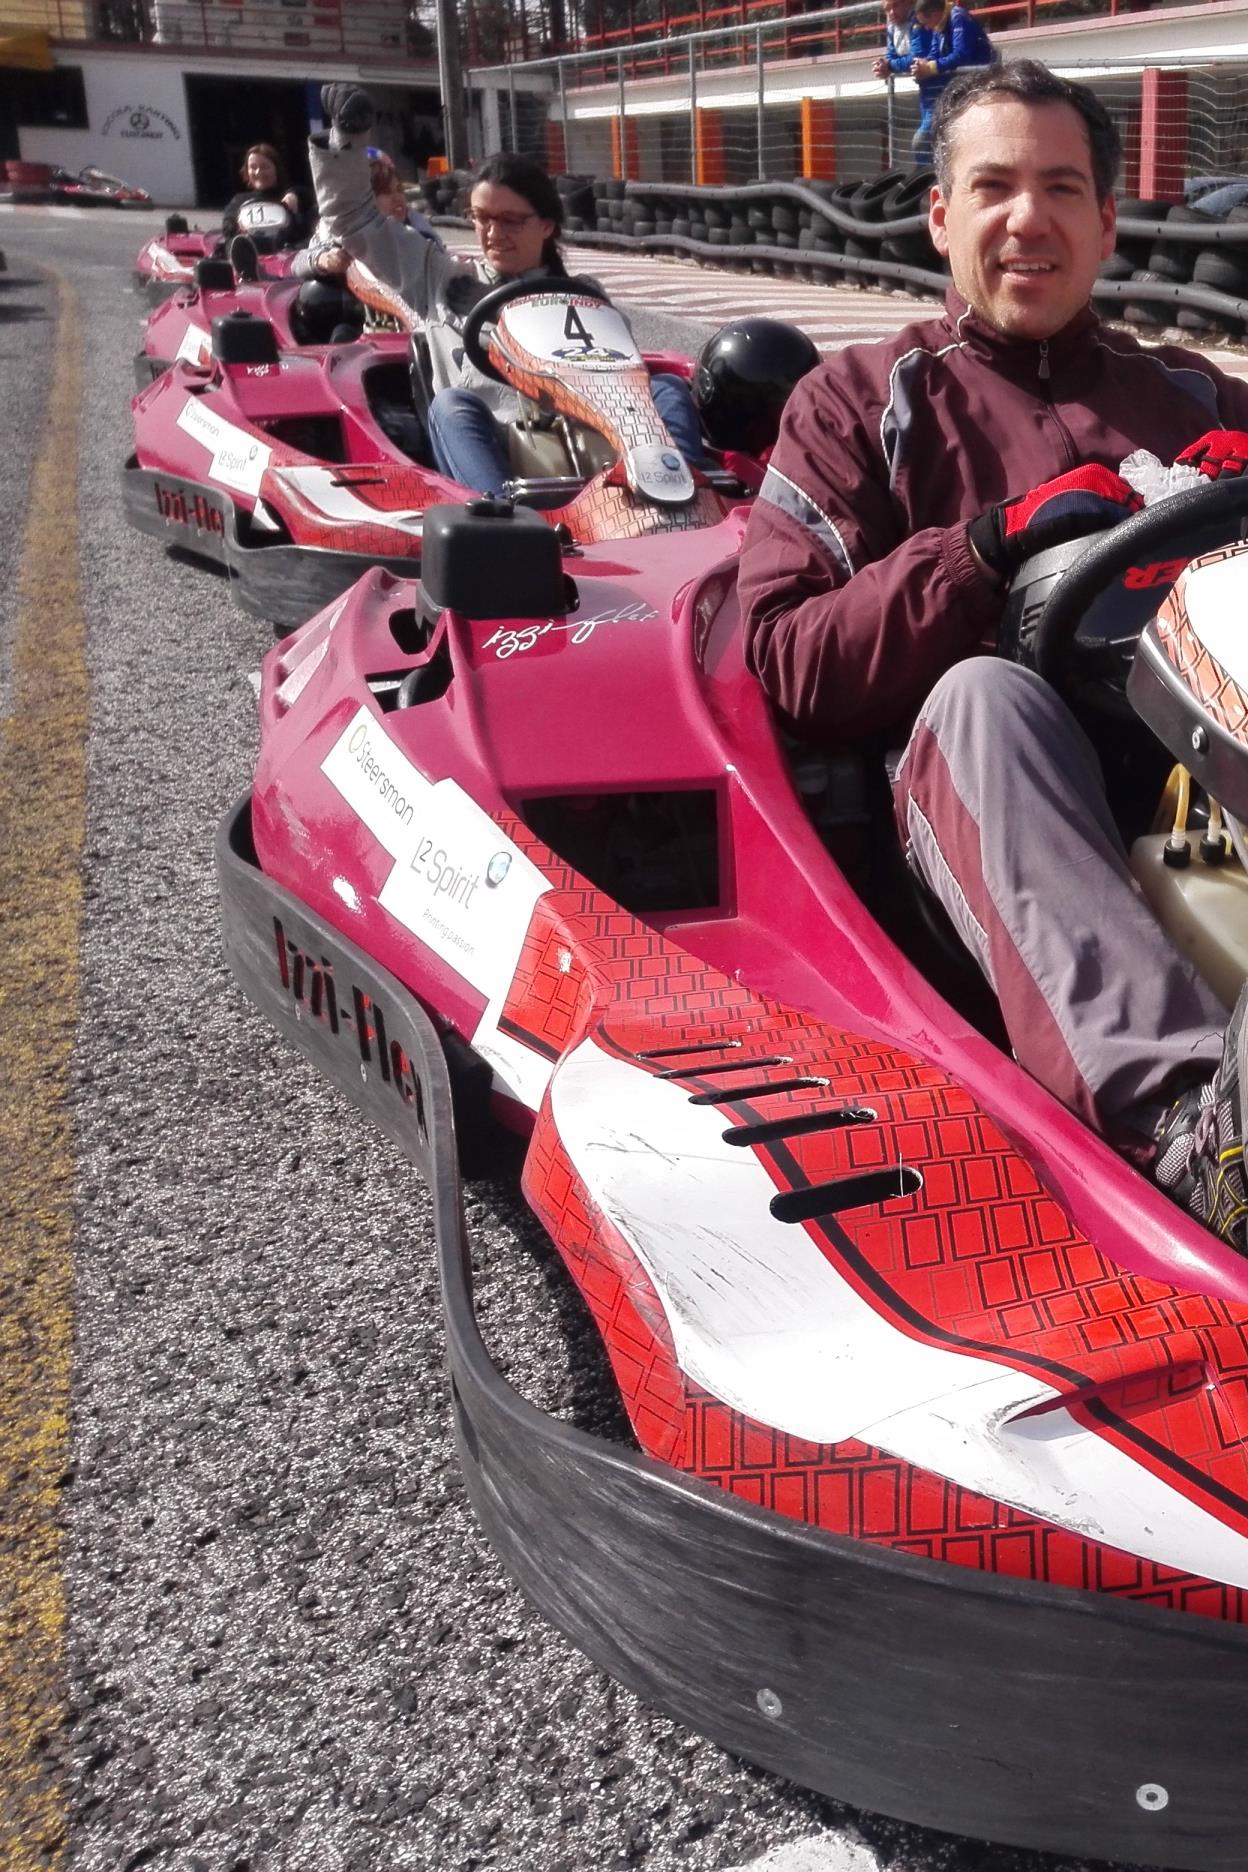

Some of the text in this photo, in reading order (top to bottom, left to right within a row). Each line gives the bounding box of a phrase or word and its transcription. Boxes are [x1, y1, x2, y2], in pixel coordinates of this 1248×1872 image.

[246, 205, 265, 226] 11
[563, 305, 595, 349] 4
[564, 347, 610, 357] 24
[355, 740, 415, 826] Steersman
